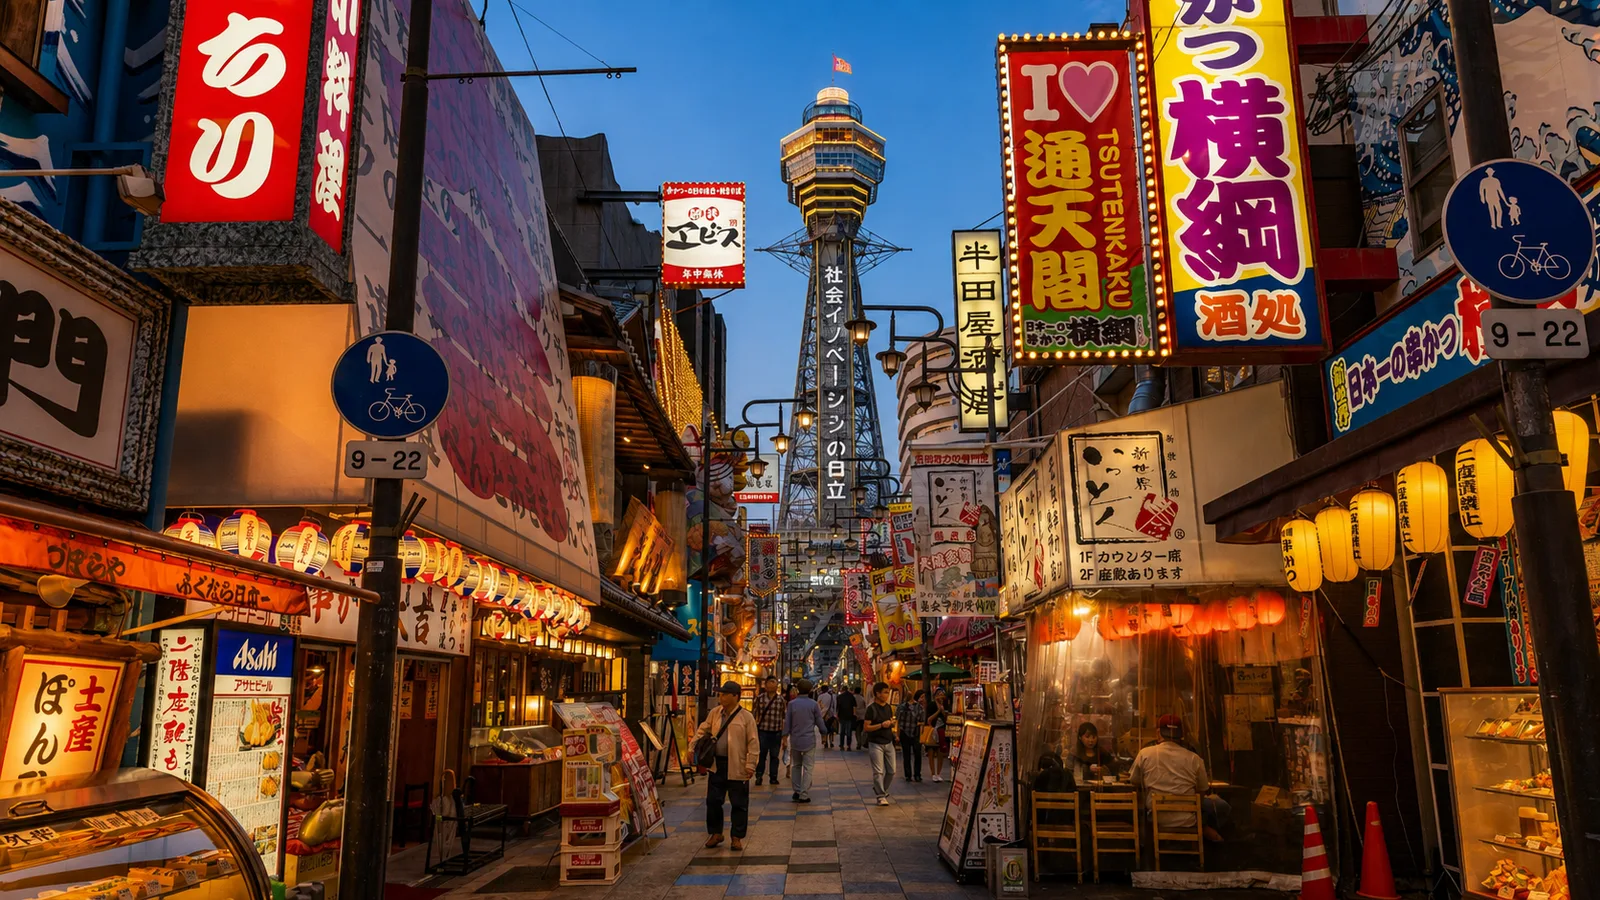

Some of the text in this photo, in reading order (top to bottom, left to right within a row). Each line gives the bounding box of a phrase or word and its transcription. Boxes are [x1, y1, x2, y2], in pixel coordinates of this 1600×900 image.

[1020, 63, 1060, 122] I
[1168, 78, 1301, 281] 横綱
[666, 221, 742, 250] エビス
[1023, 129, 1101, 311] 通天閣
[1096, 127, 1132, 308] TSUTENKAKU
[1199, 293, 1302, 337] 酒処
[1347, 317, 1457, 407] 日本一の串かつ
[1080, 549, 1182, 564] 1F カウンター席
[1080, 569, 1094, 581] 2F
[232, 638, 278, 671] Asahi
[234, 679, 273, 692] アサヒビール
[64, 675, 105, 753] 土産
